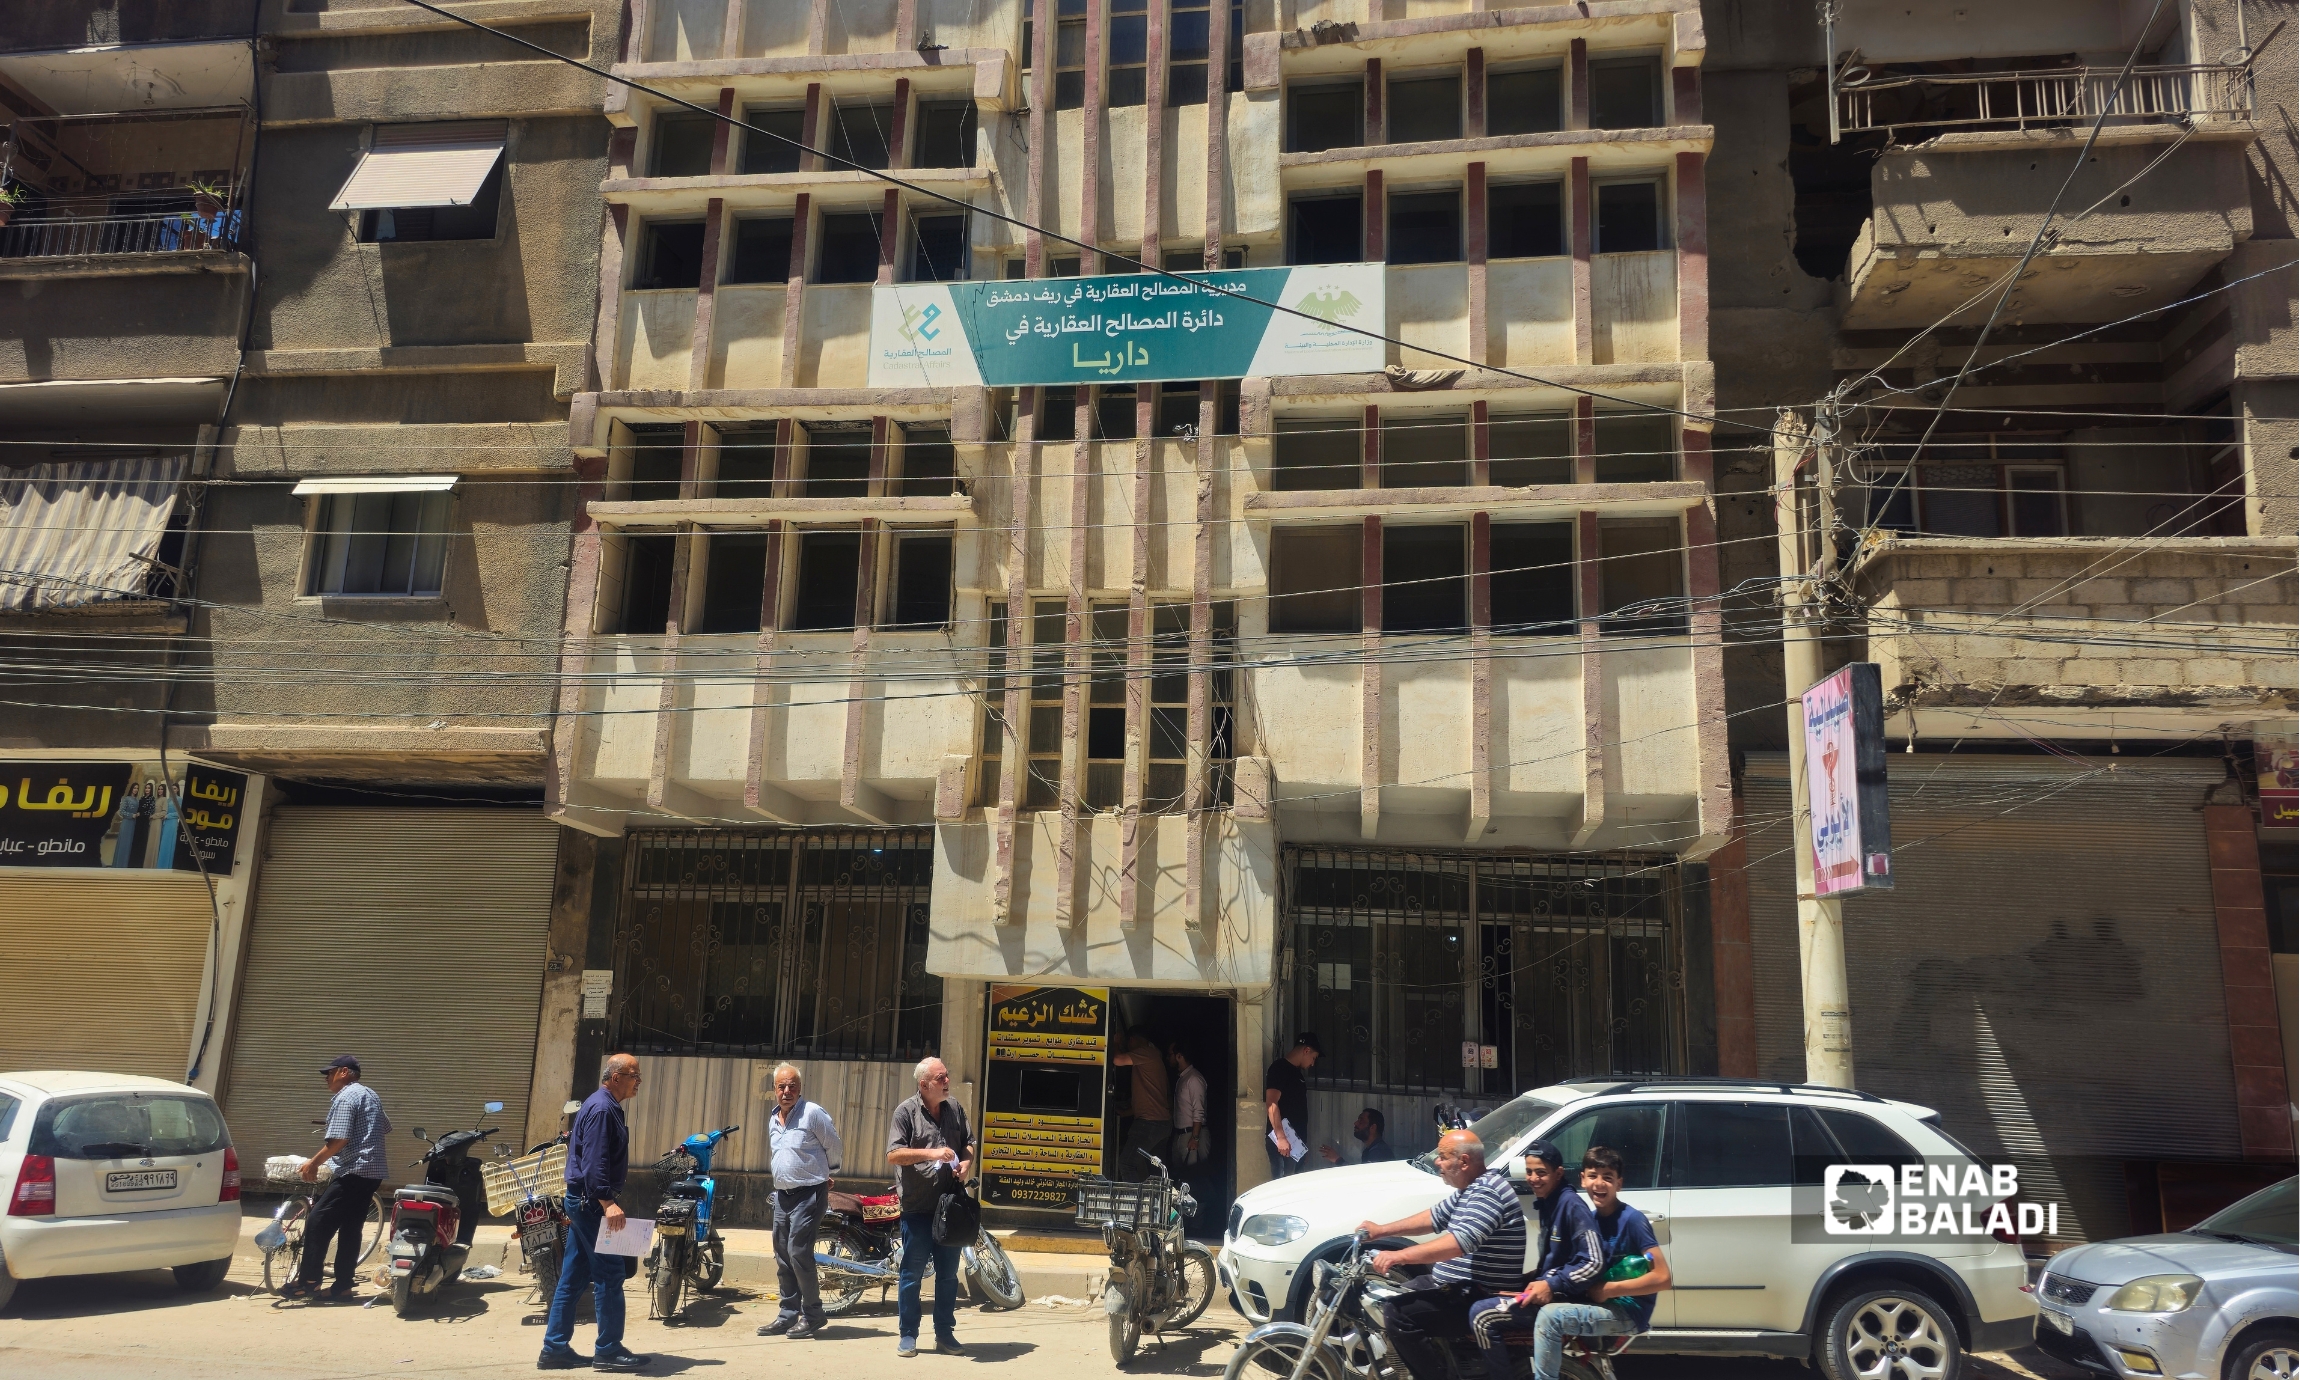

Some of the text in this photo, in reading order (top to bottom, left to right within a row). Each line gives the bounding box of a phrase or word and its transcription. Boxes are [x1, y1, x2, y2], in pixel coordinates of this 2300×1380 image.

[986, 280, 1247, 308] مديرية المصالح العقارية في ريف دمشق
[1005, 309, 1224, 346] دائرة المصالح العقارية في
[883, 348, 952, 360] المصالح العقارية
[1073, 340, 1149, 375] داريا
[923, 360, 951, 370] Affairs
[1806, 690, 1849, 738] صيدلية
[18, 777, 113, 818] ريفا
[191, 776, 238, 808] ريفا
[185, 807, 234, 831] مود
[37, 838, 86, 856] مانطو
[205, 836, 229, 848] مانطو
[998, 998, 1099, 1028] كشك الزعيم
[1022, 1035, 1041, 1045] تصوير
[1068, 1036, 1084, 1049] عقاري
[1059, 1133, 1075, 1143] كافة
[1011, 1189, 1067, 1202] 0937229827
